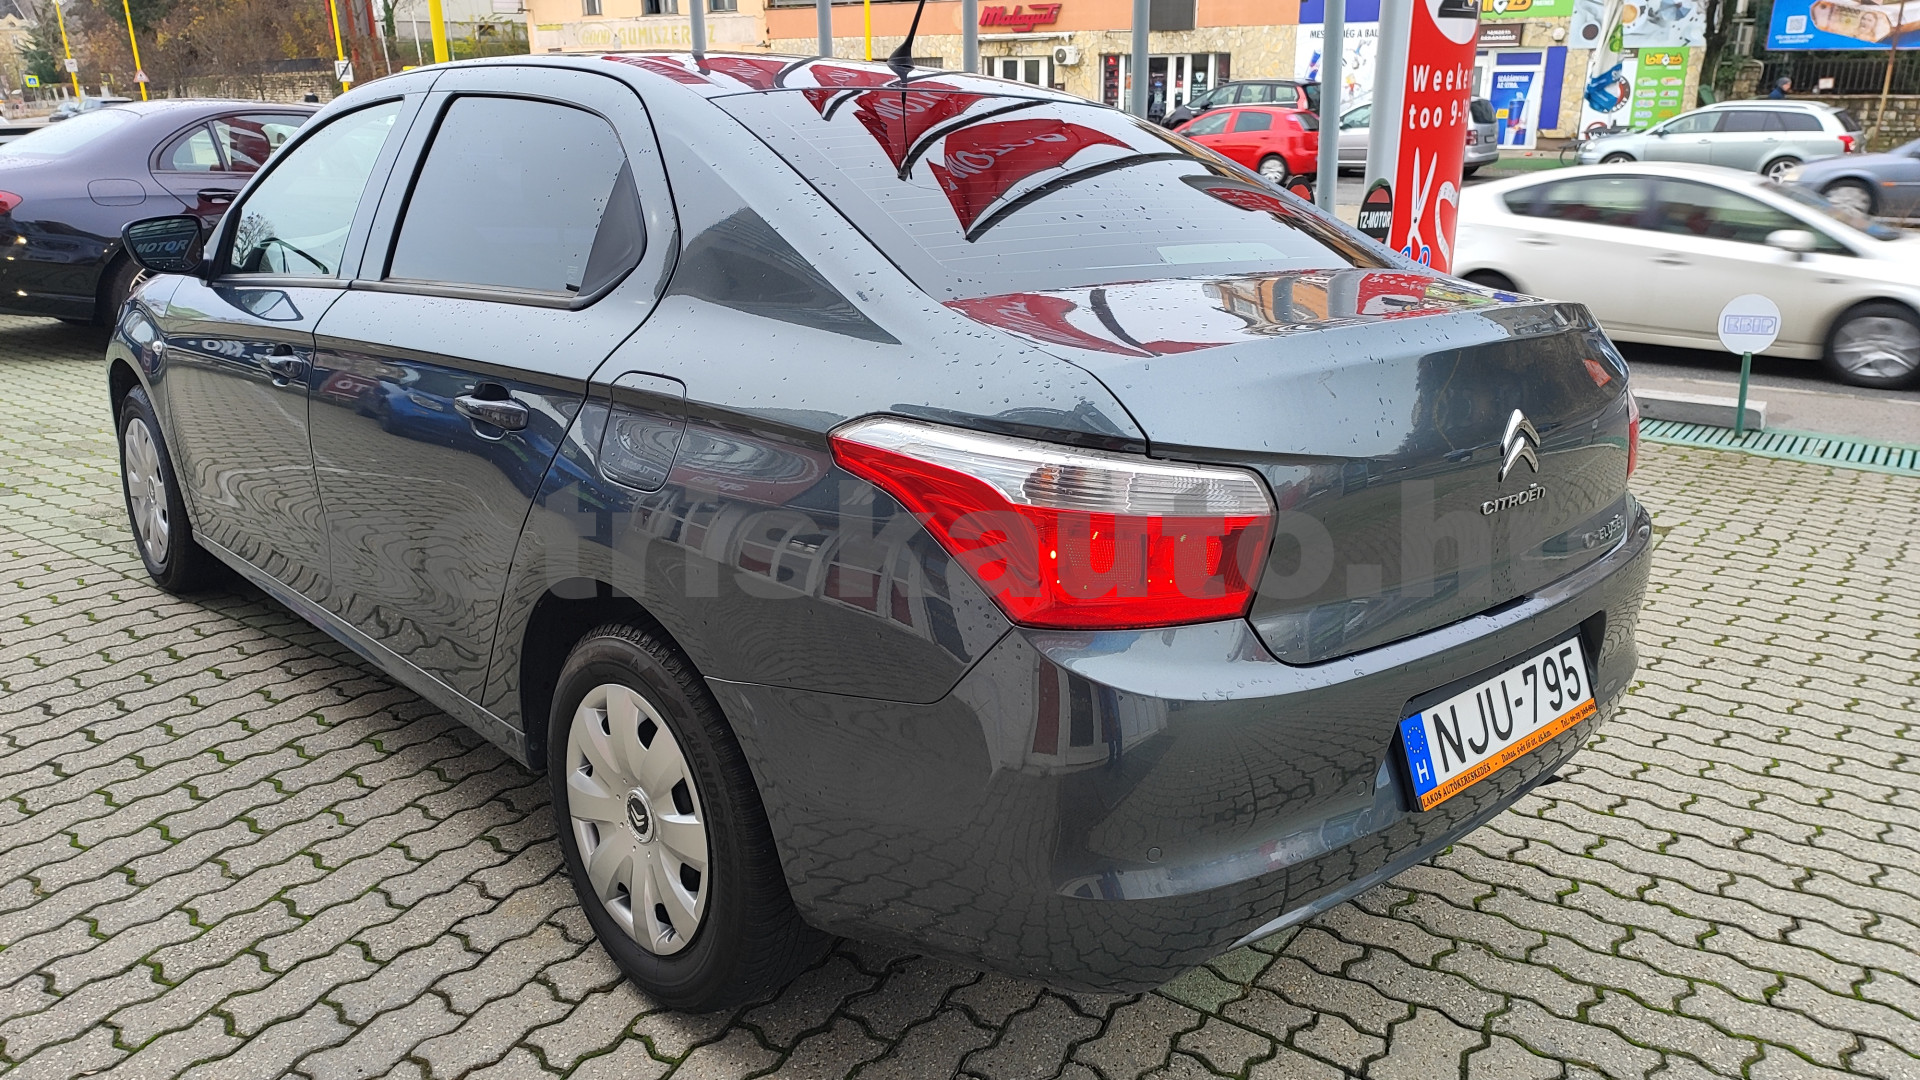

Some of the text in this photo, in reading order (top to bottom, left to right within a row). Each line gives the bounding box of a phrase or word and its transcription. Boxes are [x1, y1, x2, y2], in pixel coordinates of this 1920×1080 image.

[619, 24, 716, 45] GUMISZERZ
[1365, 28, 1379, 38] BAL
[1409, 104, 1443, 130] too
[1359, 211, 1392, 229] TZ-MOTOR
[1432, 646, 1581, 773] NJU-795
[1416, 758, 1430, 784] H
[1422, 789, 1443, 808] LAKOS
[1442, 762, 1492, 798] AUTÓKERESKEDÉS
